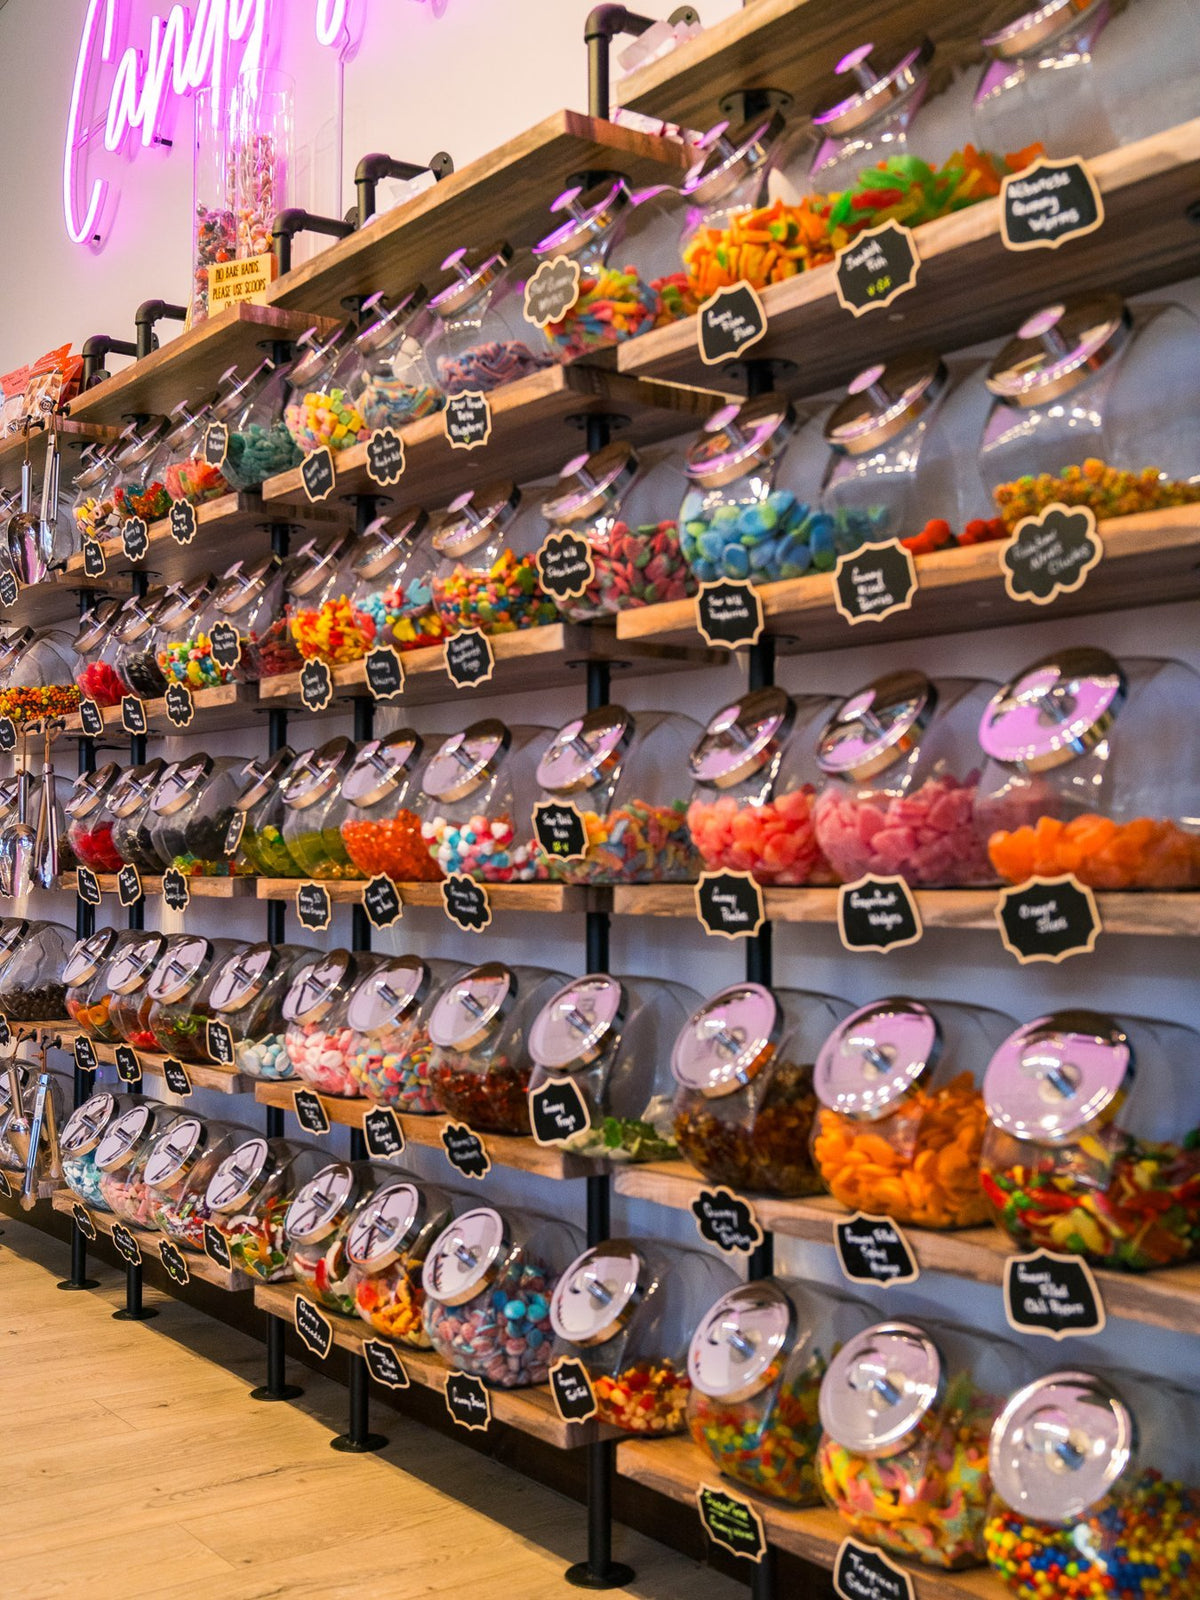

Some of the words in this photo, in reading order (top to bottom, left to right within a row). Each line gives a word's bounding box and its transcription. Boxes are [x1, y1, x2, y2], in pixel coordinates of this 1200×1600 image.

[215, 267, 225, 283] NO
[225, 264, 239, 279] BARE
[241, 261, 259, 276] HANDS
[212, 285, 231, 300] PLEASE
[233, 283, 242, 296] USE
[244, 278, 266, 294] SCOOPS
[542, 1098, 565, 1115] Gummy
[702, 1201, 739, 1229] Gummy
[299, 1300, 319, 1329] Gummy
[848, 1552, 900, 1597] Tropical
